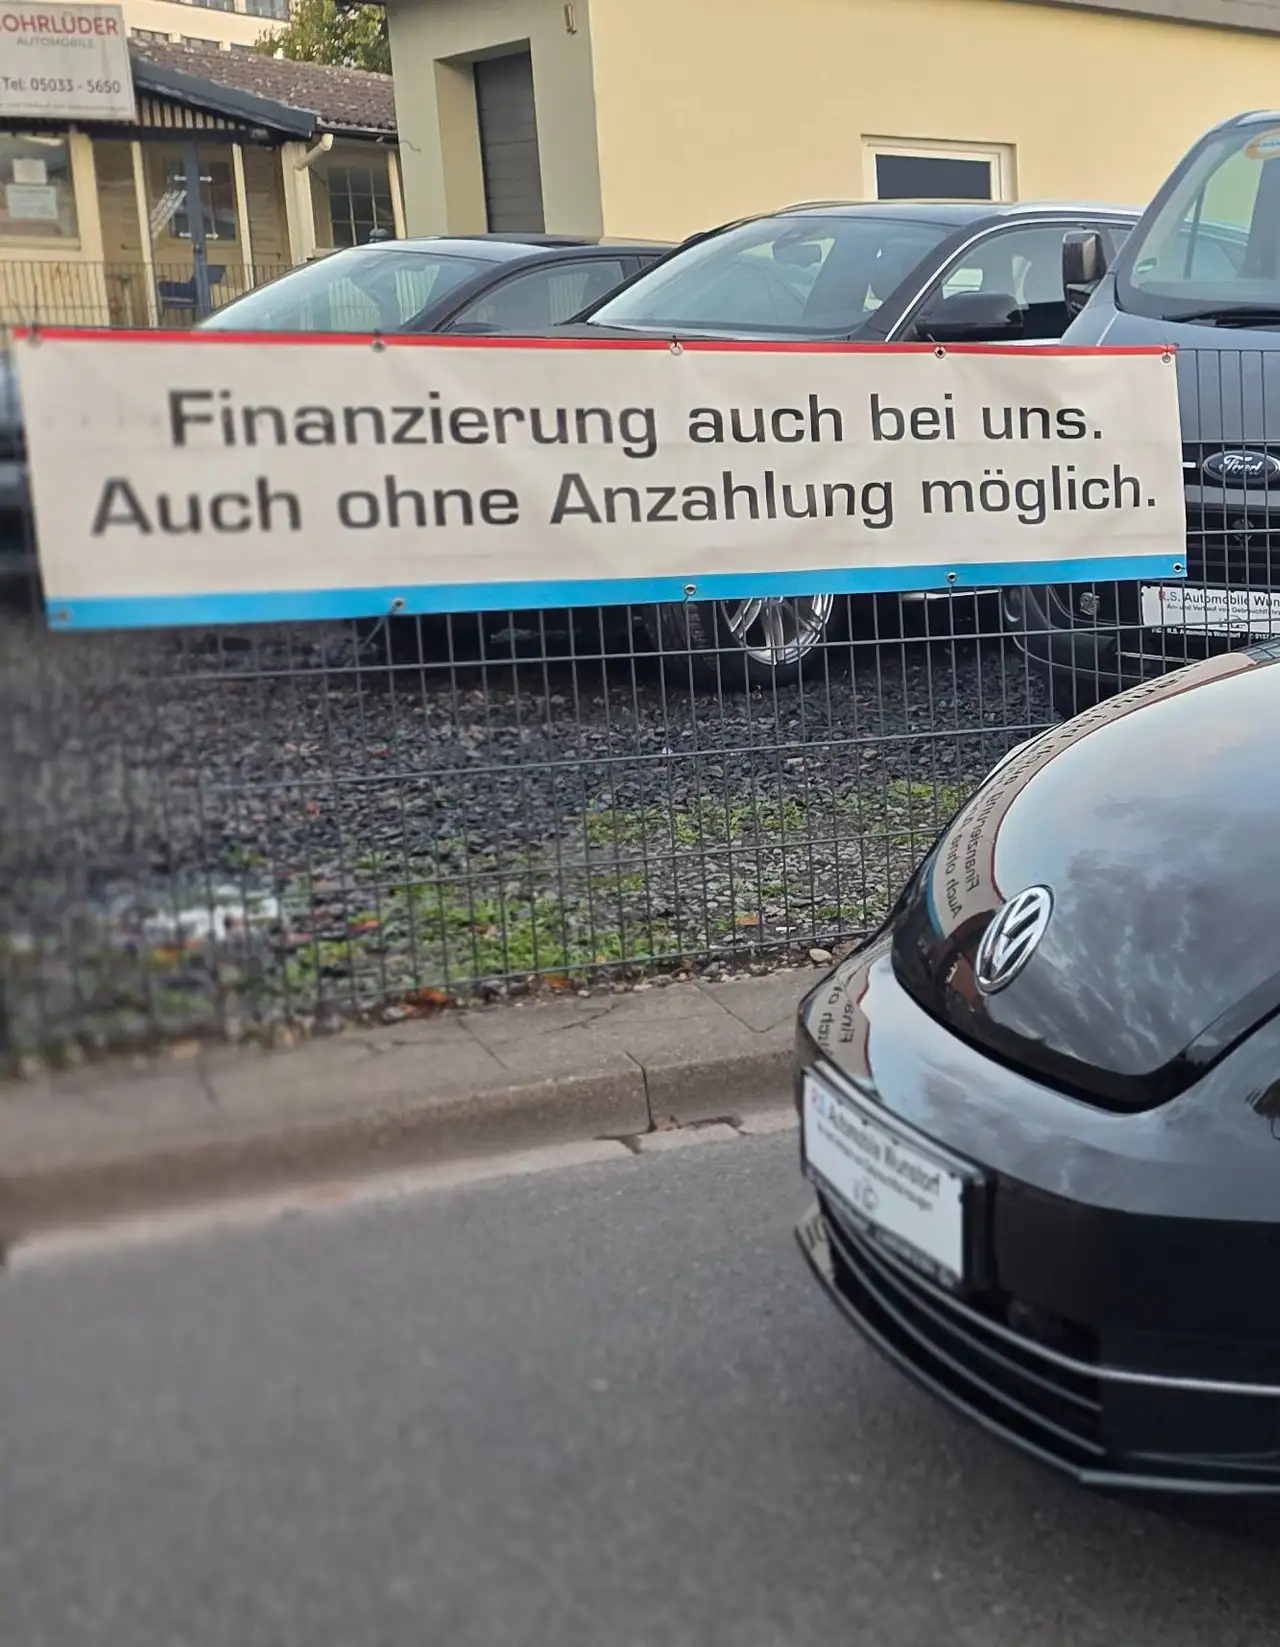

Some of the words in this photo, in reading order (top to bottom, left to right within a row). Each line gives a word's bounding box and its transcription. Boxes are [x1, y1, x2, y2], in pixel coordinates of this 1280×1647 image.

[0, 11, 118, 35] OHRLÜDER
[17, 37, 95, 48] AUTOMOBILE
[30, 78, 74, 92] 05033
[87, 79, 121, 94] 5650
[168, 391, 657, 459] Finanzierung
[688, 394, 843, 444] auch
[870, 393, 956, 441] bei
[982, 405, 1102, 440] uns.
[90, 475, 302, 536] Auch
[337, 474, 520, 530] ohne
[549, 470, 894, 530] Anzahlung
[921, 464, 1156, 526] möglich.
